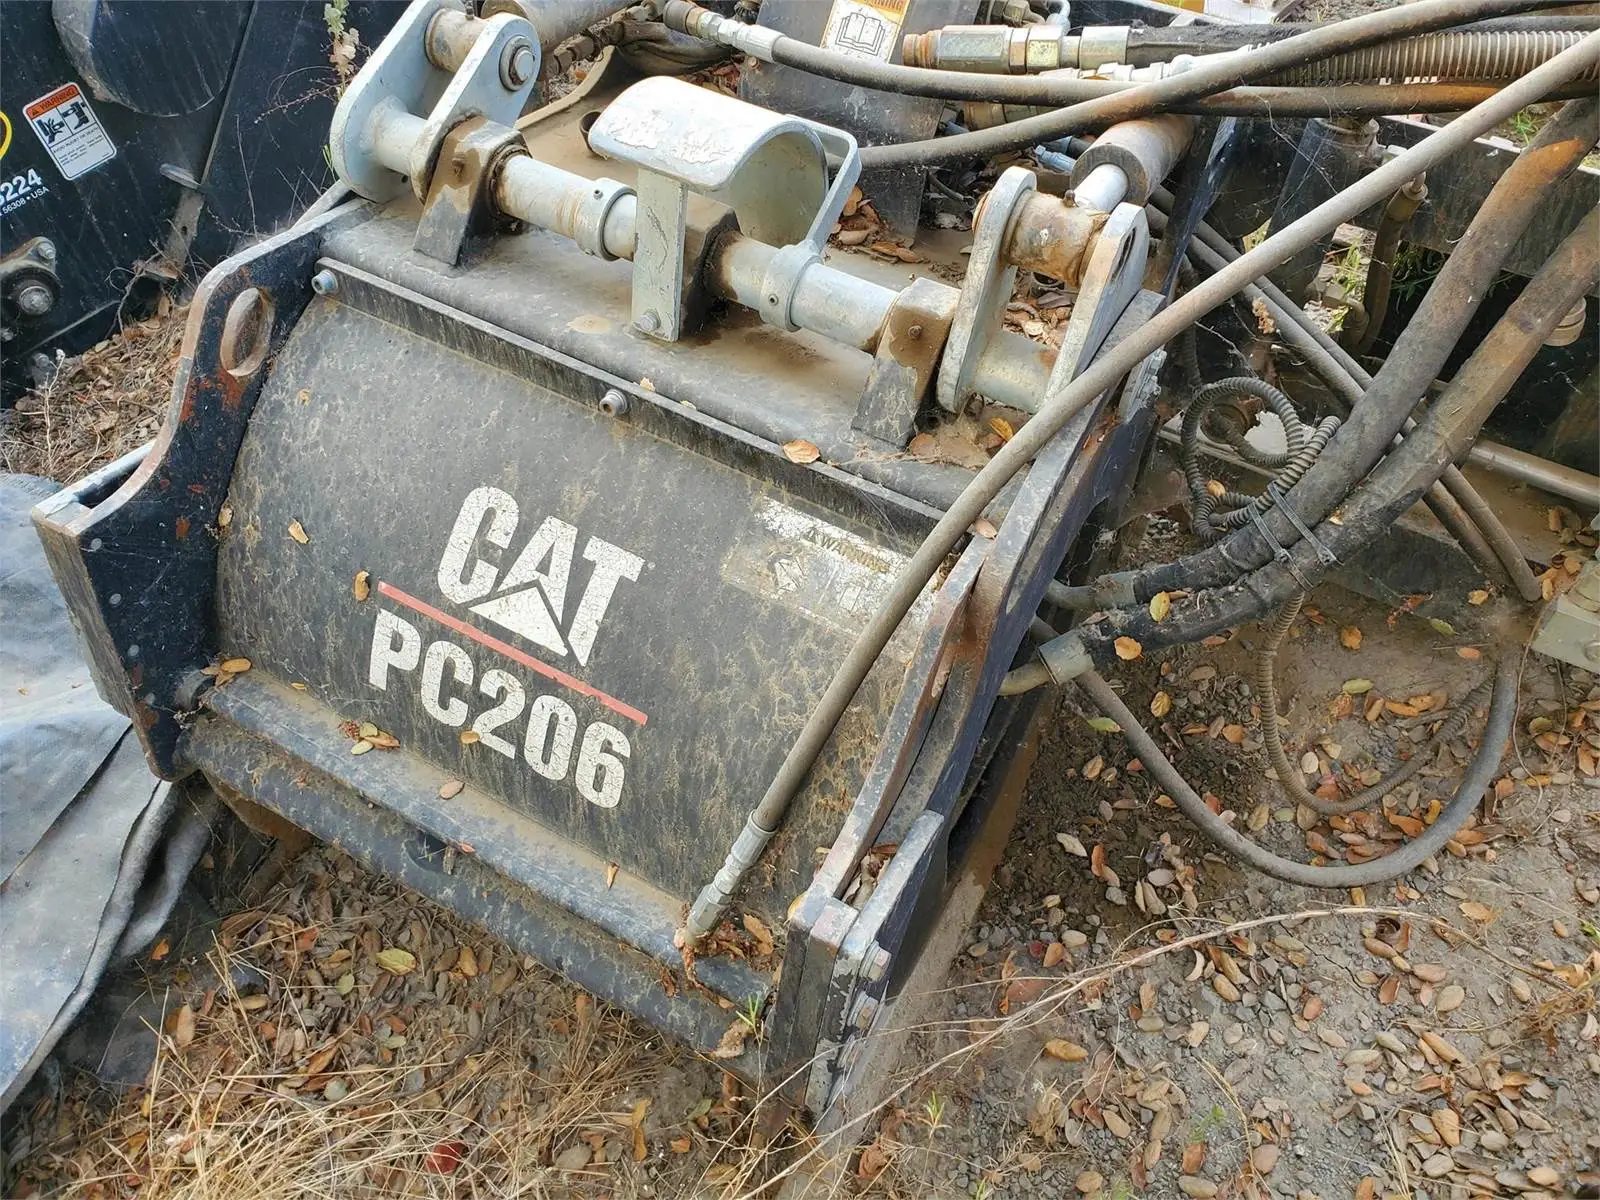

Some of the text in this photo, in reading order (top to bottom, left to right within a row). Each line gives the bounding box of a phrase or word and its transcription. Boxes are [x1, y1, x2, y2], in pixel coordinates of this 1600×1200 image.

[40, 87, 75, 109] WARNING
[30, 186, 49, 199] USA
[437, 486, 646, 667] CAT
[369, 608, 631, 809] PC206
